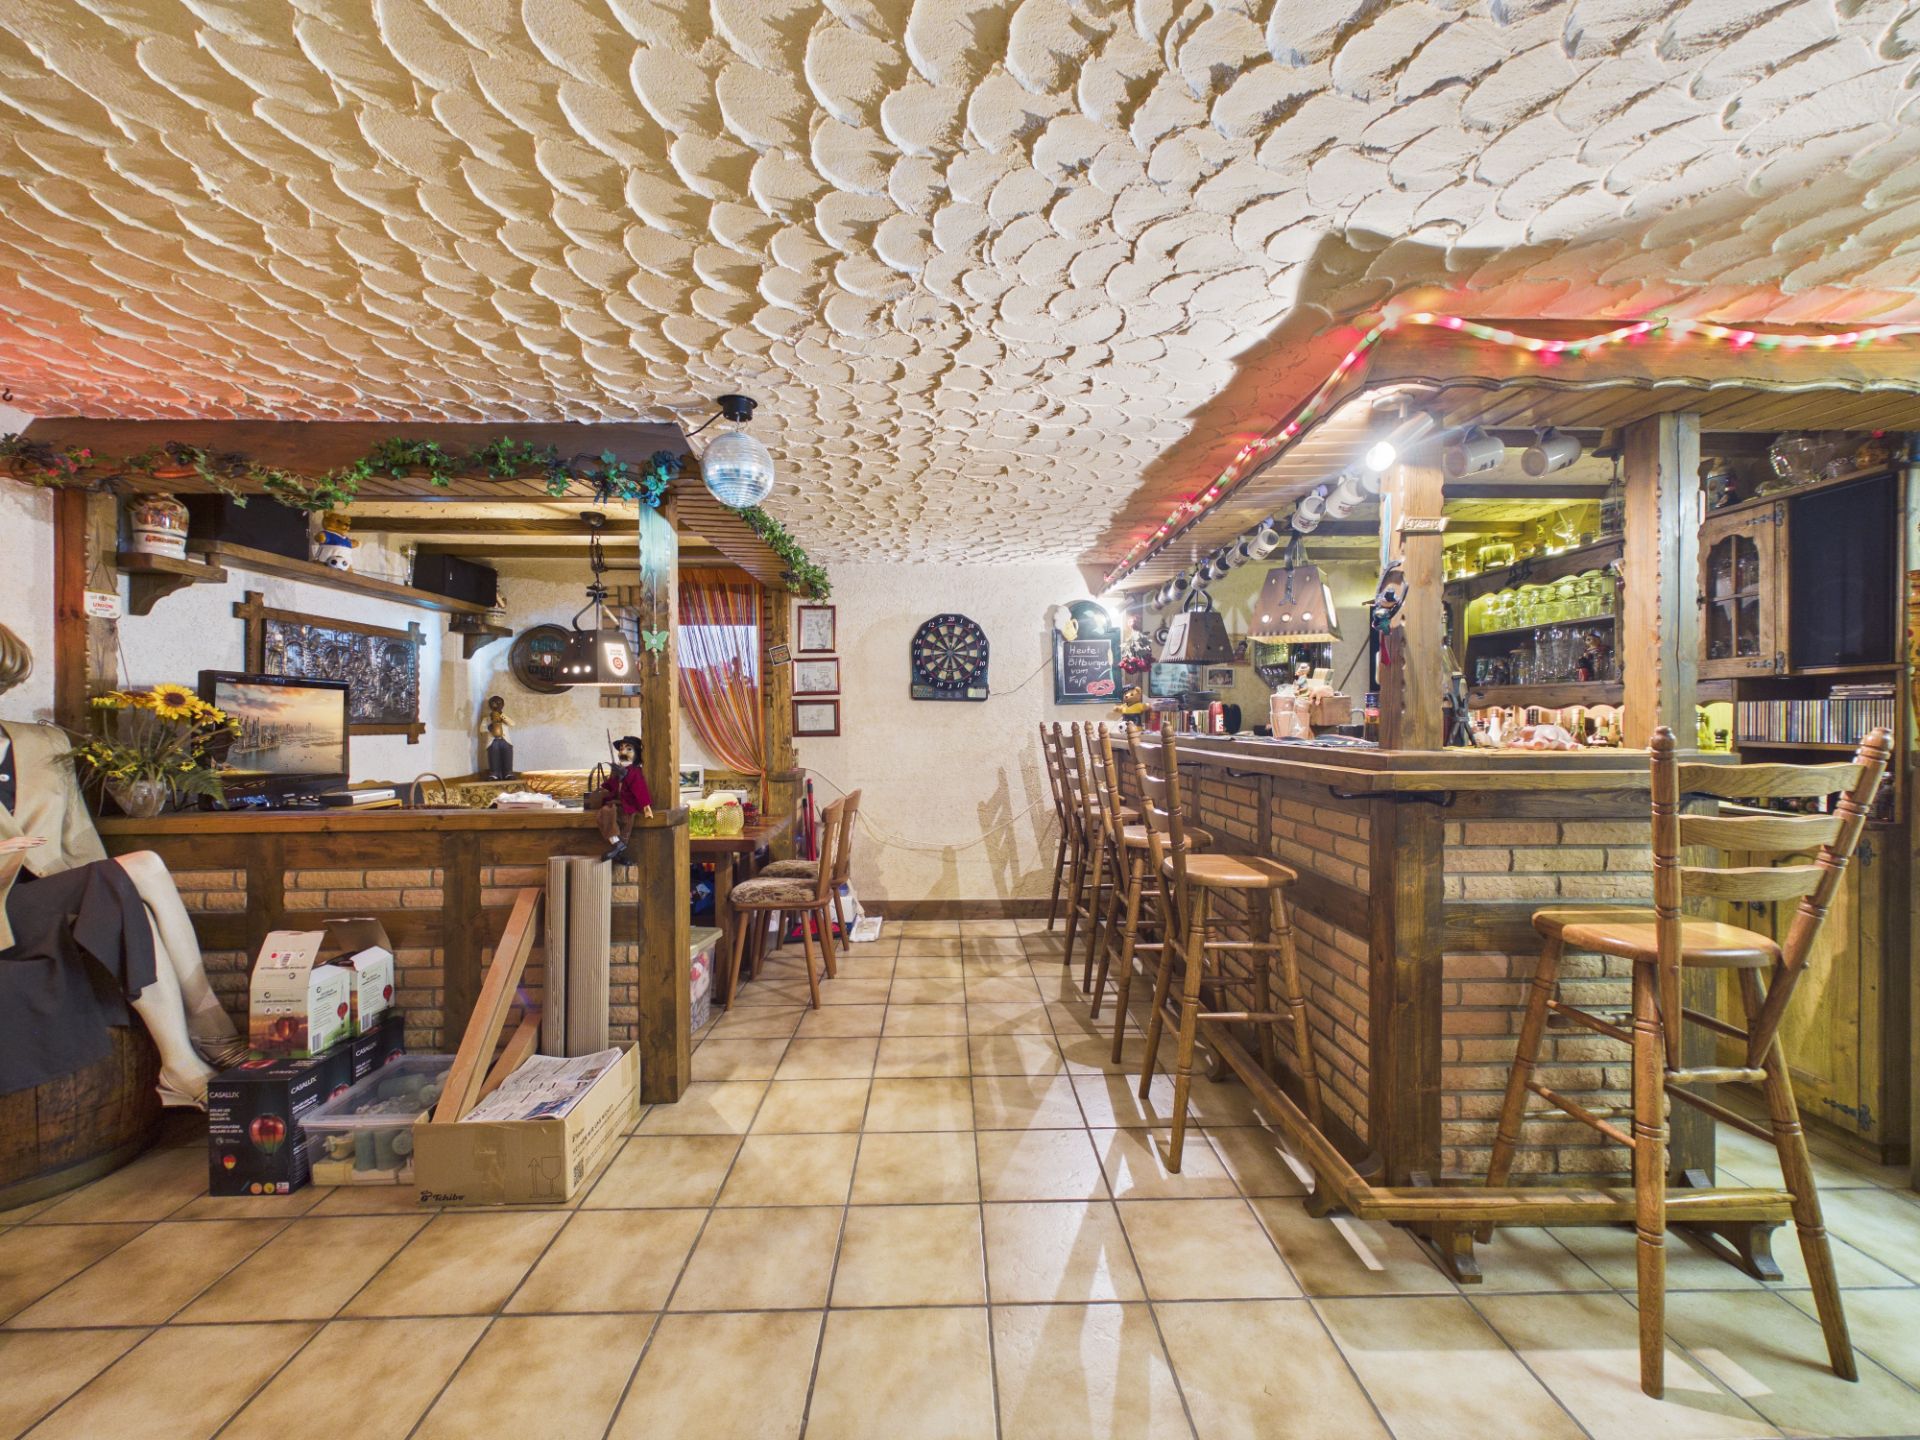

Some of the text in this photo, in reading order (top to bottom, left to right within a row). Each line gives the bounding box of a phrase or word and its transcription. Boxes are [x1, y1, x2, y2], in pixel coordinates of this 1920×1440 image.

[1068, 658, 1108, 670] Bitburger
[290, 1076, 318, 1094] CASALLUX
[432, 1193, 464, 1201] Tchibo
